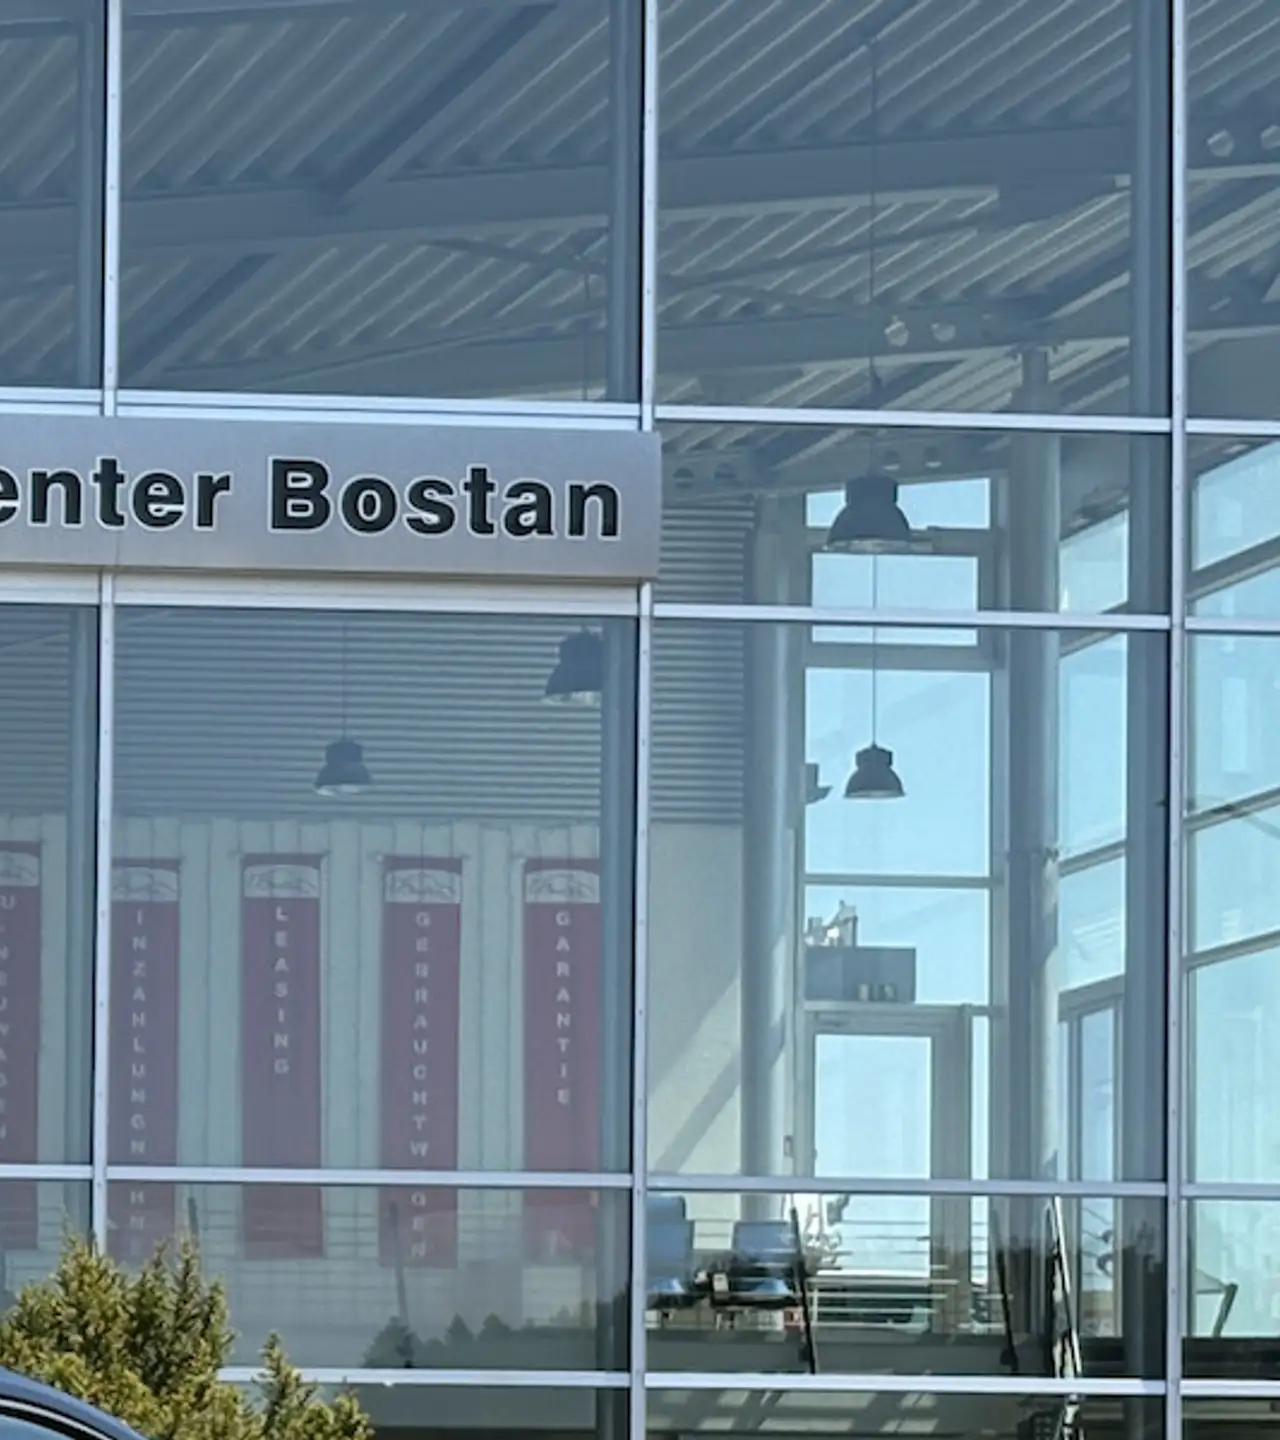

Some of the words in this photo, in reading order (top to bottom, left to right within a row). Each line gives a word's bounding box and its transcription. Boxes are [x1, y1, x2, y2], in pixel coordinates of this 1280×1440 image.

[268, 456, 622, 540] Bostan
[274, 906, 290, 1076] LEASING
[555, 911, 571, 1106] GARANTIE
[409, 911, 431, 1259] GEBRAUCHTWGEN
